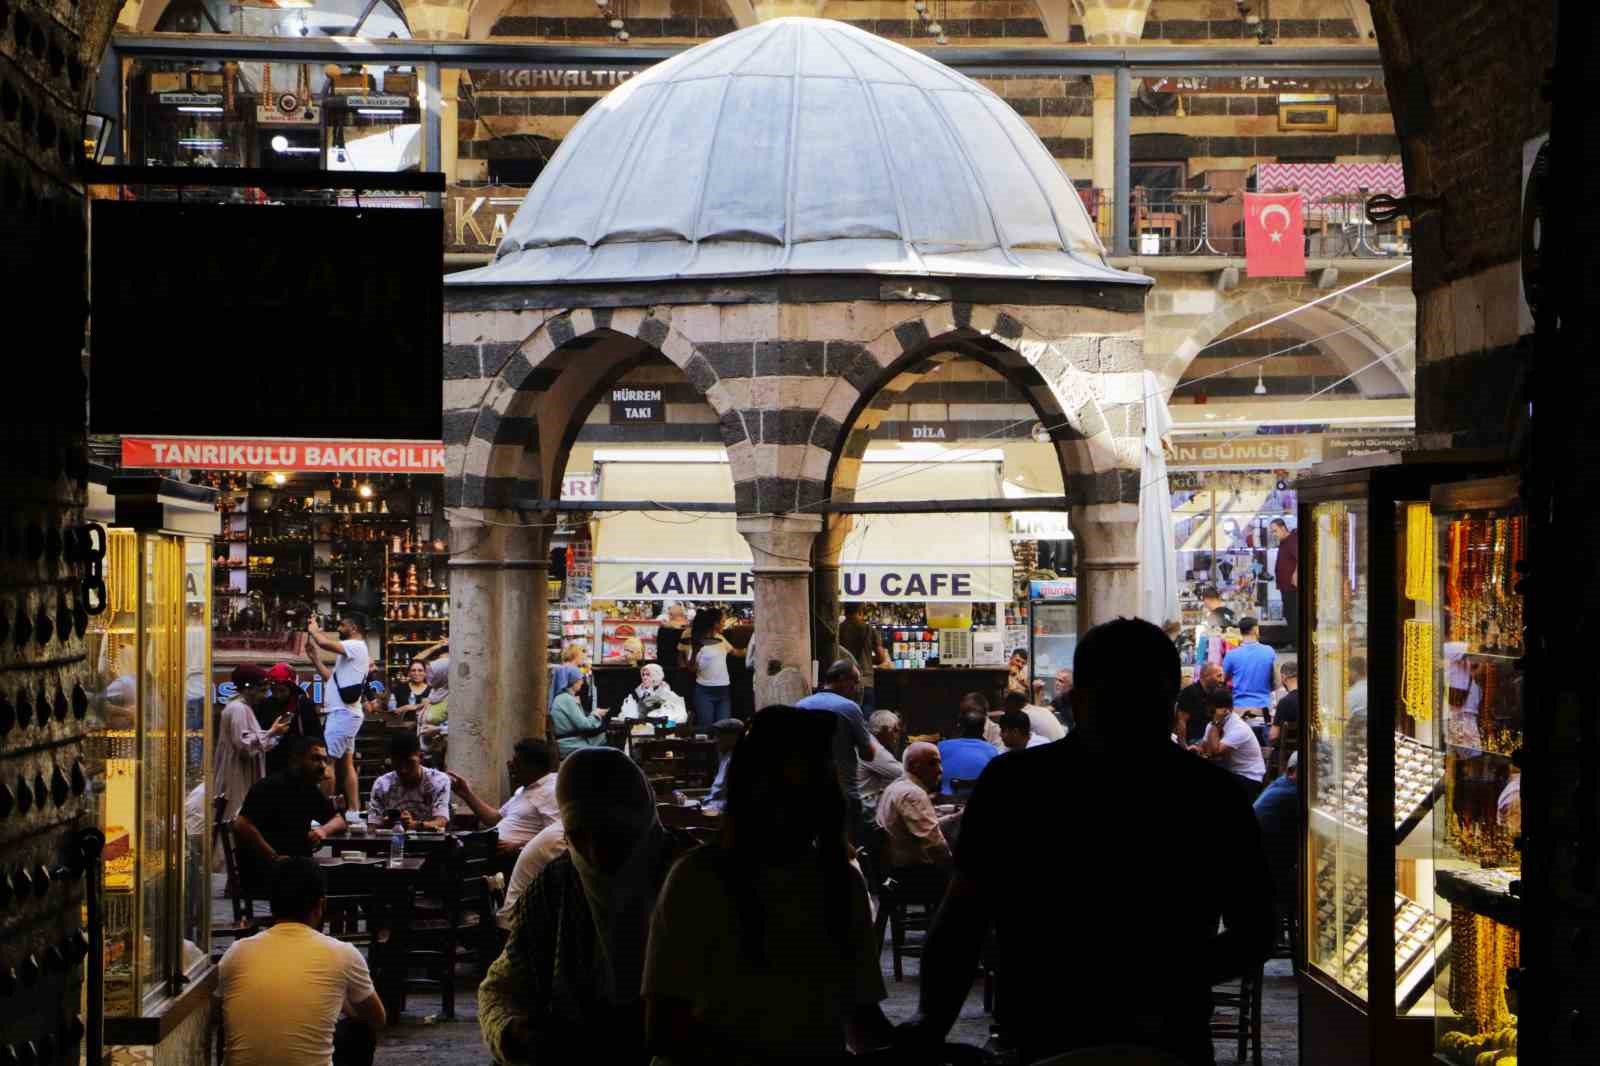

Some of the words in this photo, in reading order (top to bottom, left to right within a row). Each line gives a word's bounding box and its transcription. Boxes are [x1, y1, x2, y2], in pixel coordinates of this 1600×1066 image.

[453, 196, 518, 246] KA
[612, 387, 662, 401] HÜRREM
[624, 407, 653, 419] TAKI
[911, 424, 946, 439] DİLA
[151, 442, 297, 466] TANRIKULU
[304, 446, 446, 468] BAKIRCILIK
[1201, 442, 1289, 462] GÜMÜŞ
[879, 572, 972, 597] CAFE
